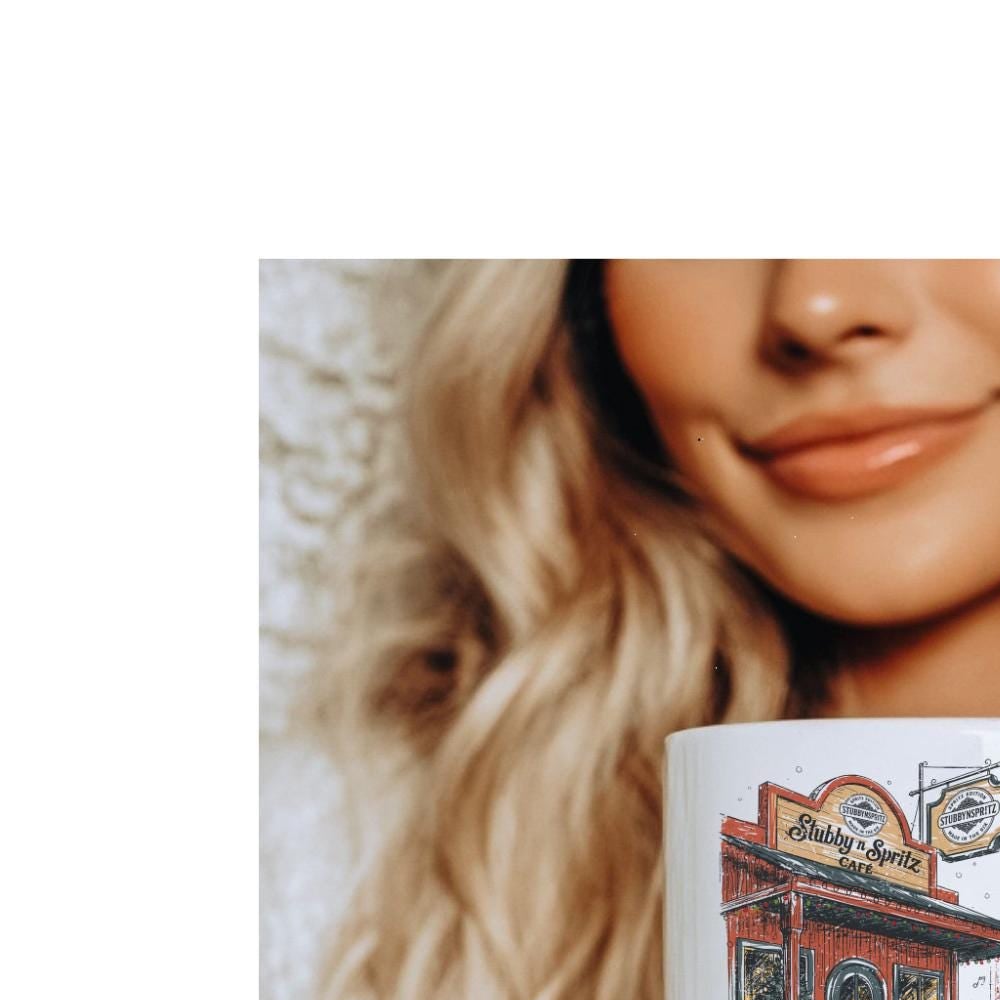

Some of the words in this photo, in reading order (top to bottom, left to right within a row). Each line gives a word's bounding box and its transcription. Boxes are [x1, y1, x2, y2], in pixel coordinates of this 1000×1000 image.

[939, 802, 997, 827] STUBBYNSPRITZ
[786, 813, 854, 854] Stubby
[865, 839, 922, 874] Spritz
[838, 856, 873, 875] CAFÉ
